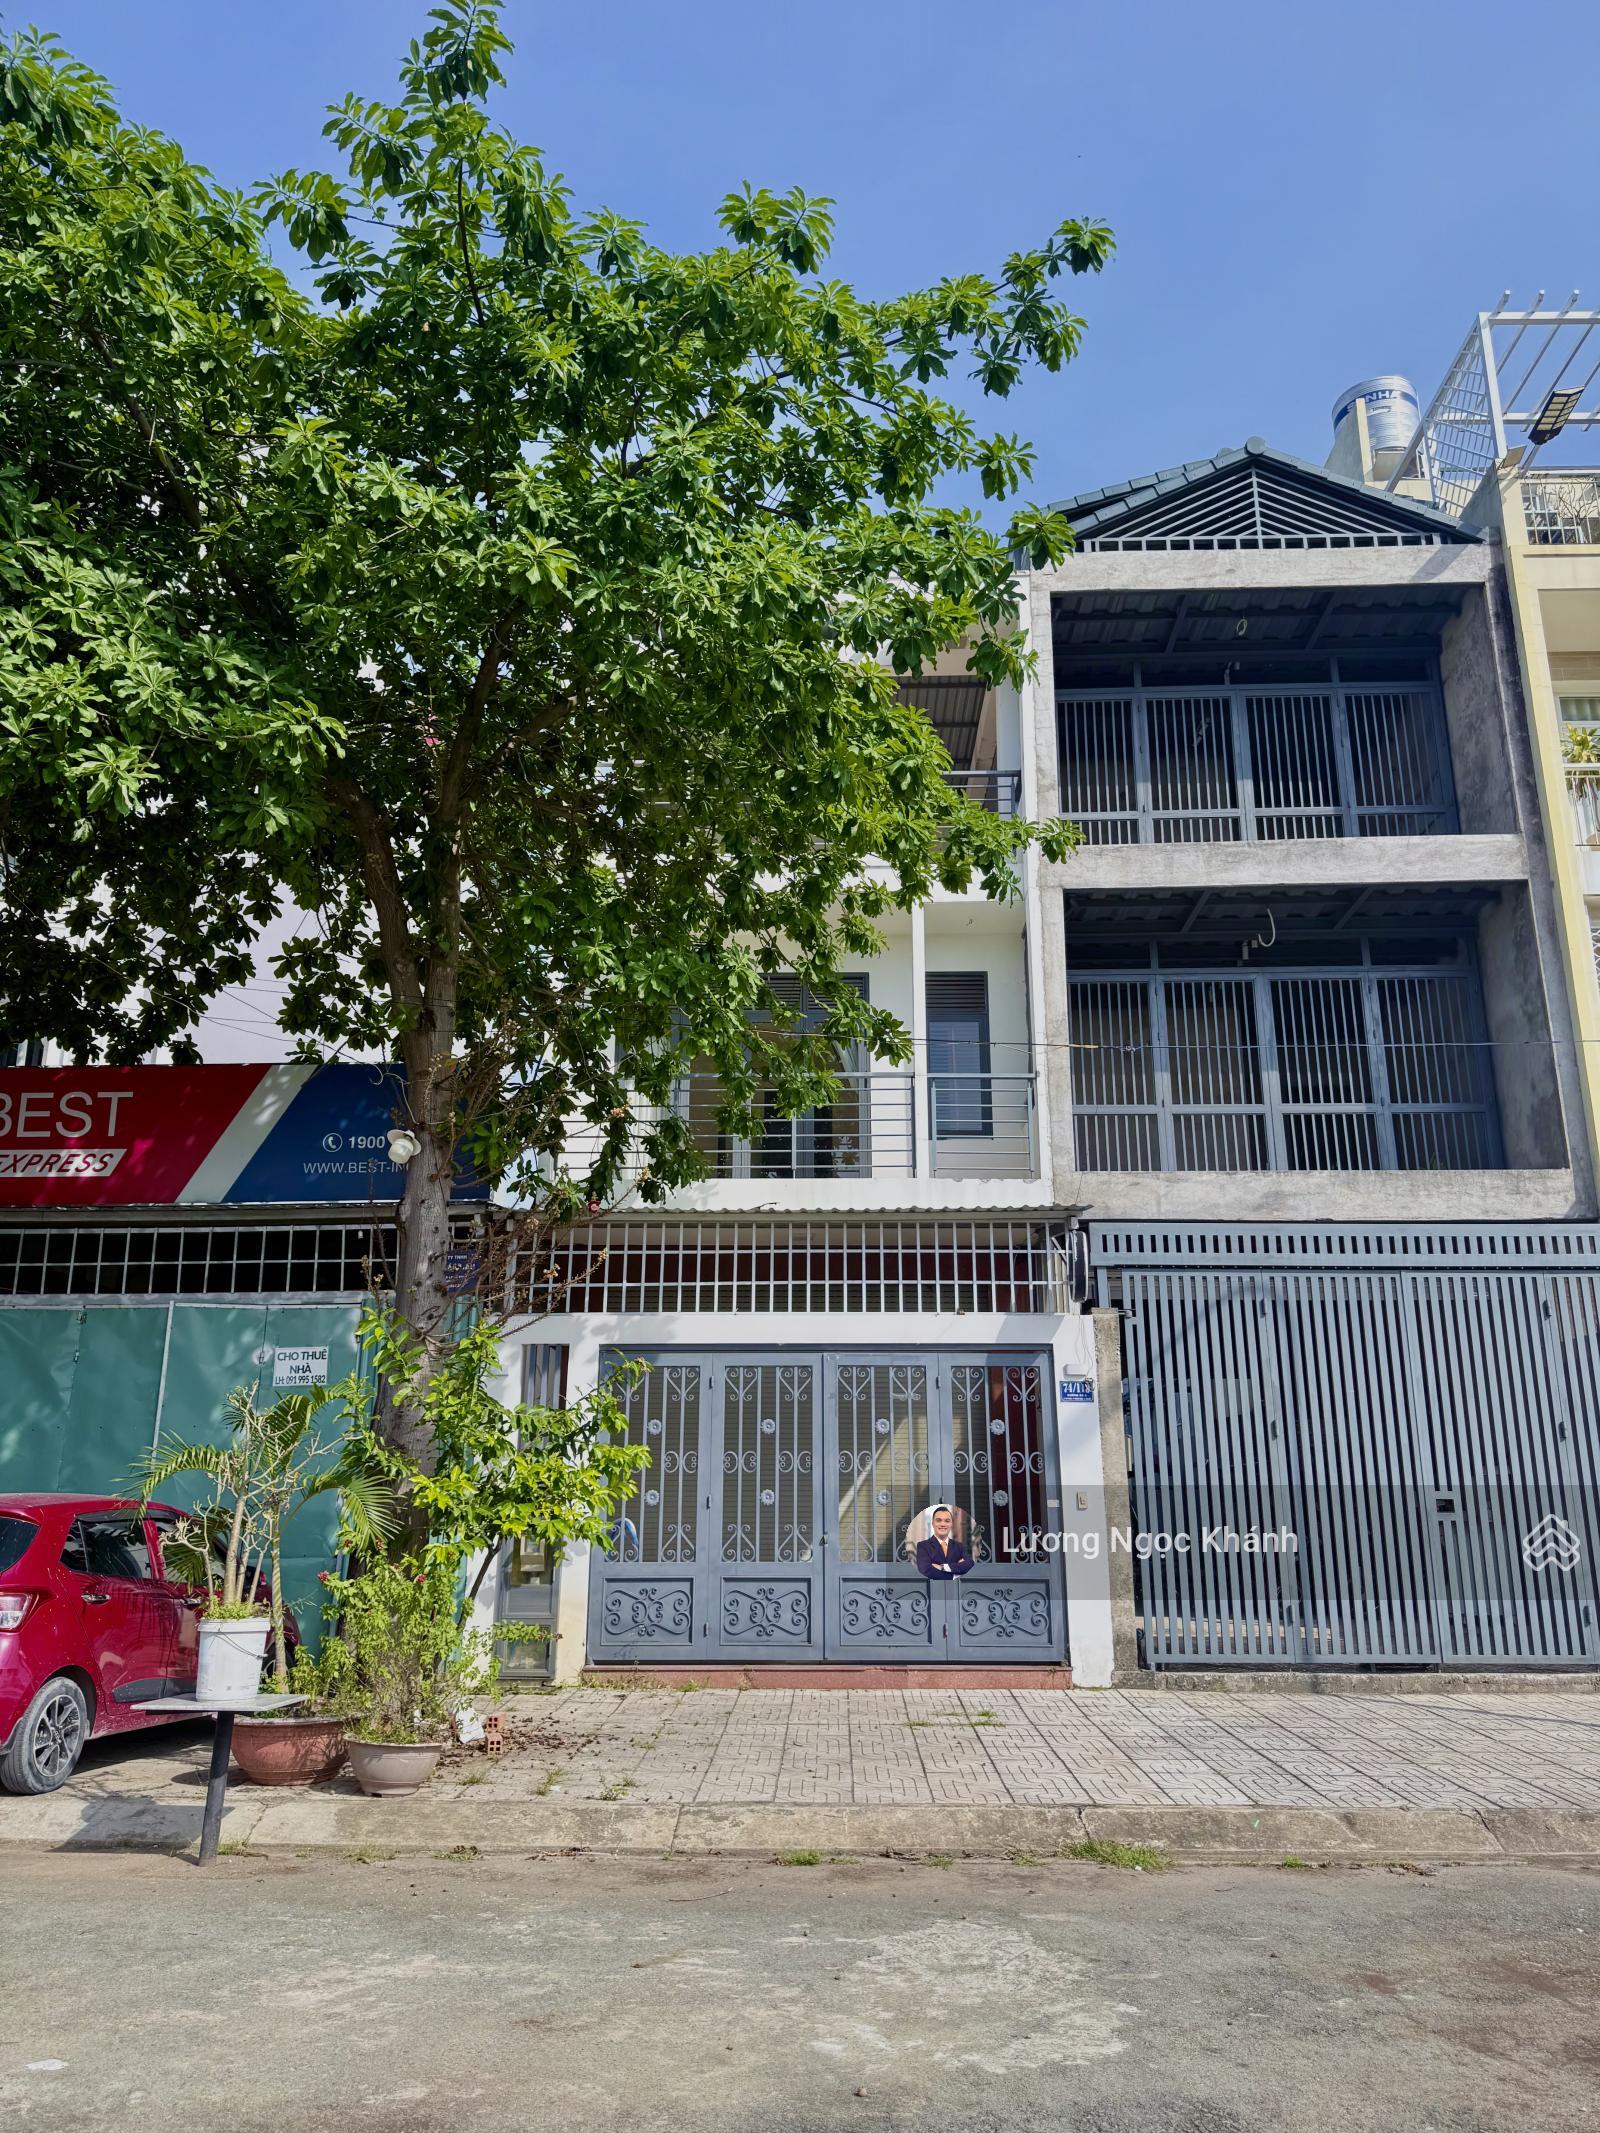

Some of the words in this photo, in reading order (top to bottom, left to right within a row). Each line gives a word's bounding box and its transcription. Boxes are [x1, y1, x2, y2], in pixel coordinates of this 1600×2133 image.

[348, 1136, 386, 1149] 1900
[277, 1352, 300, 1361] CHO
[301, 1349, 327, 1360] THUÊ
[289, 1362, 312, 1374] NHÀ
[285, 1376, 297, 1385] 091
[297, 1375, 310, 1385] 995
